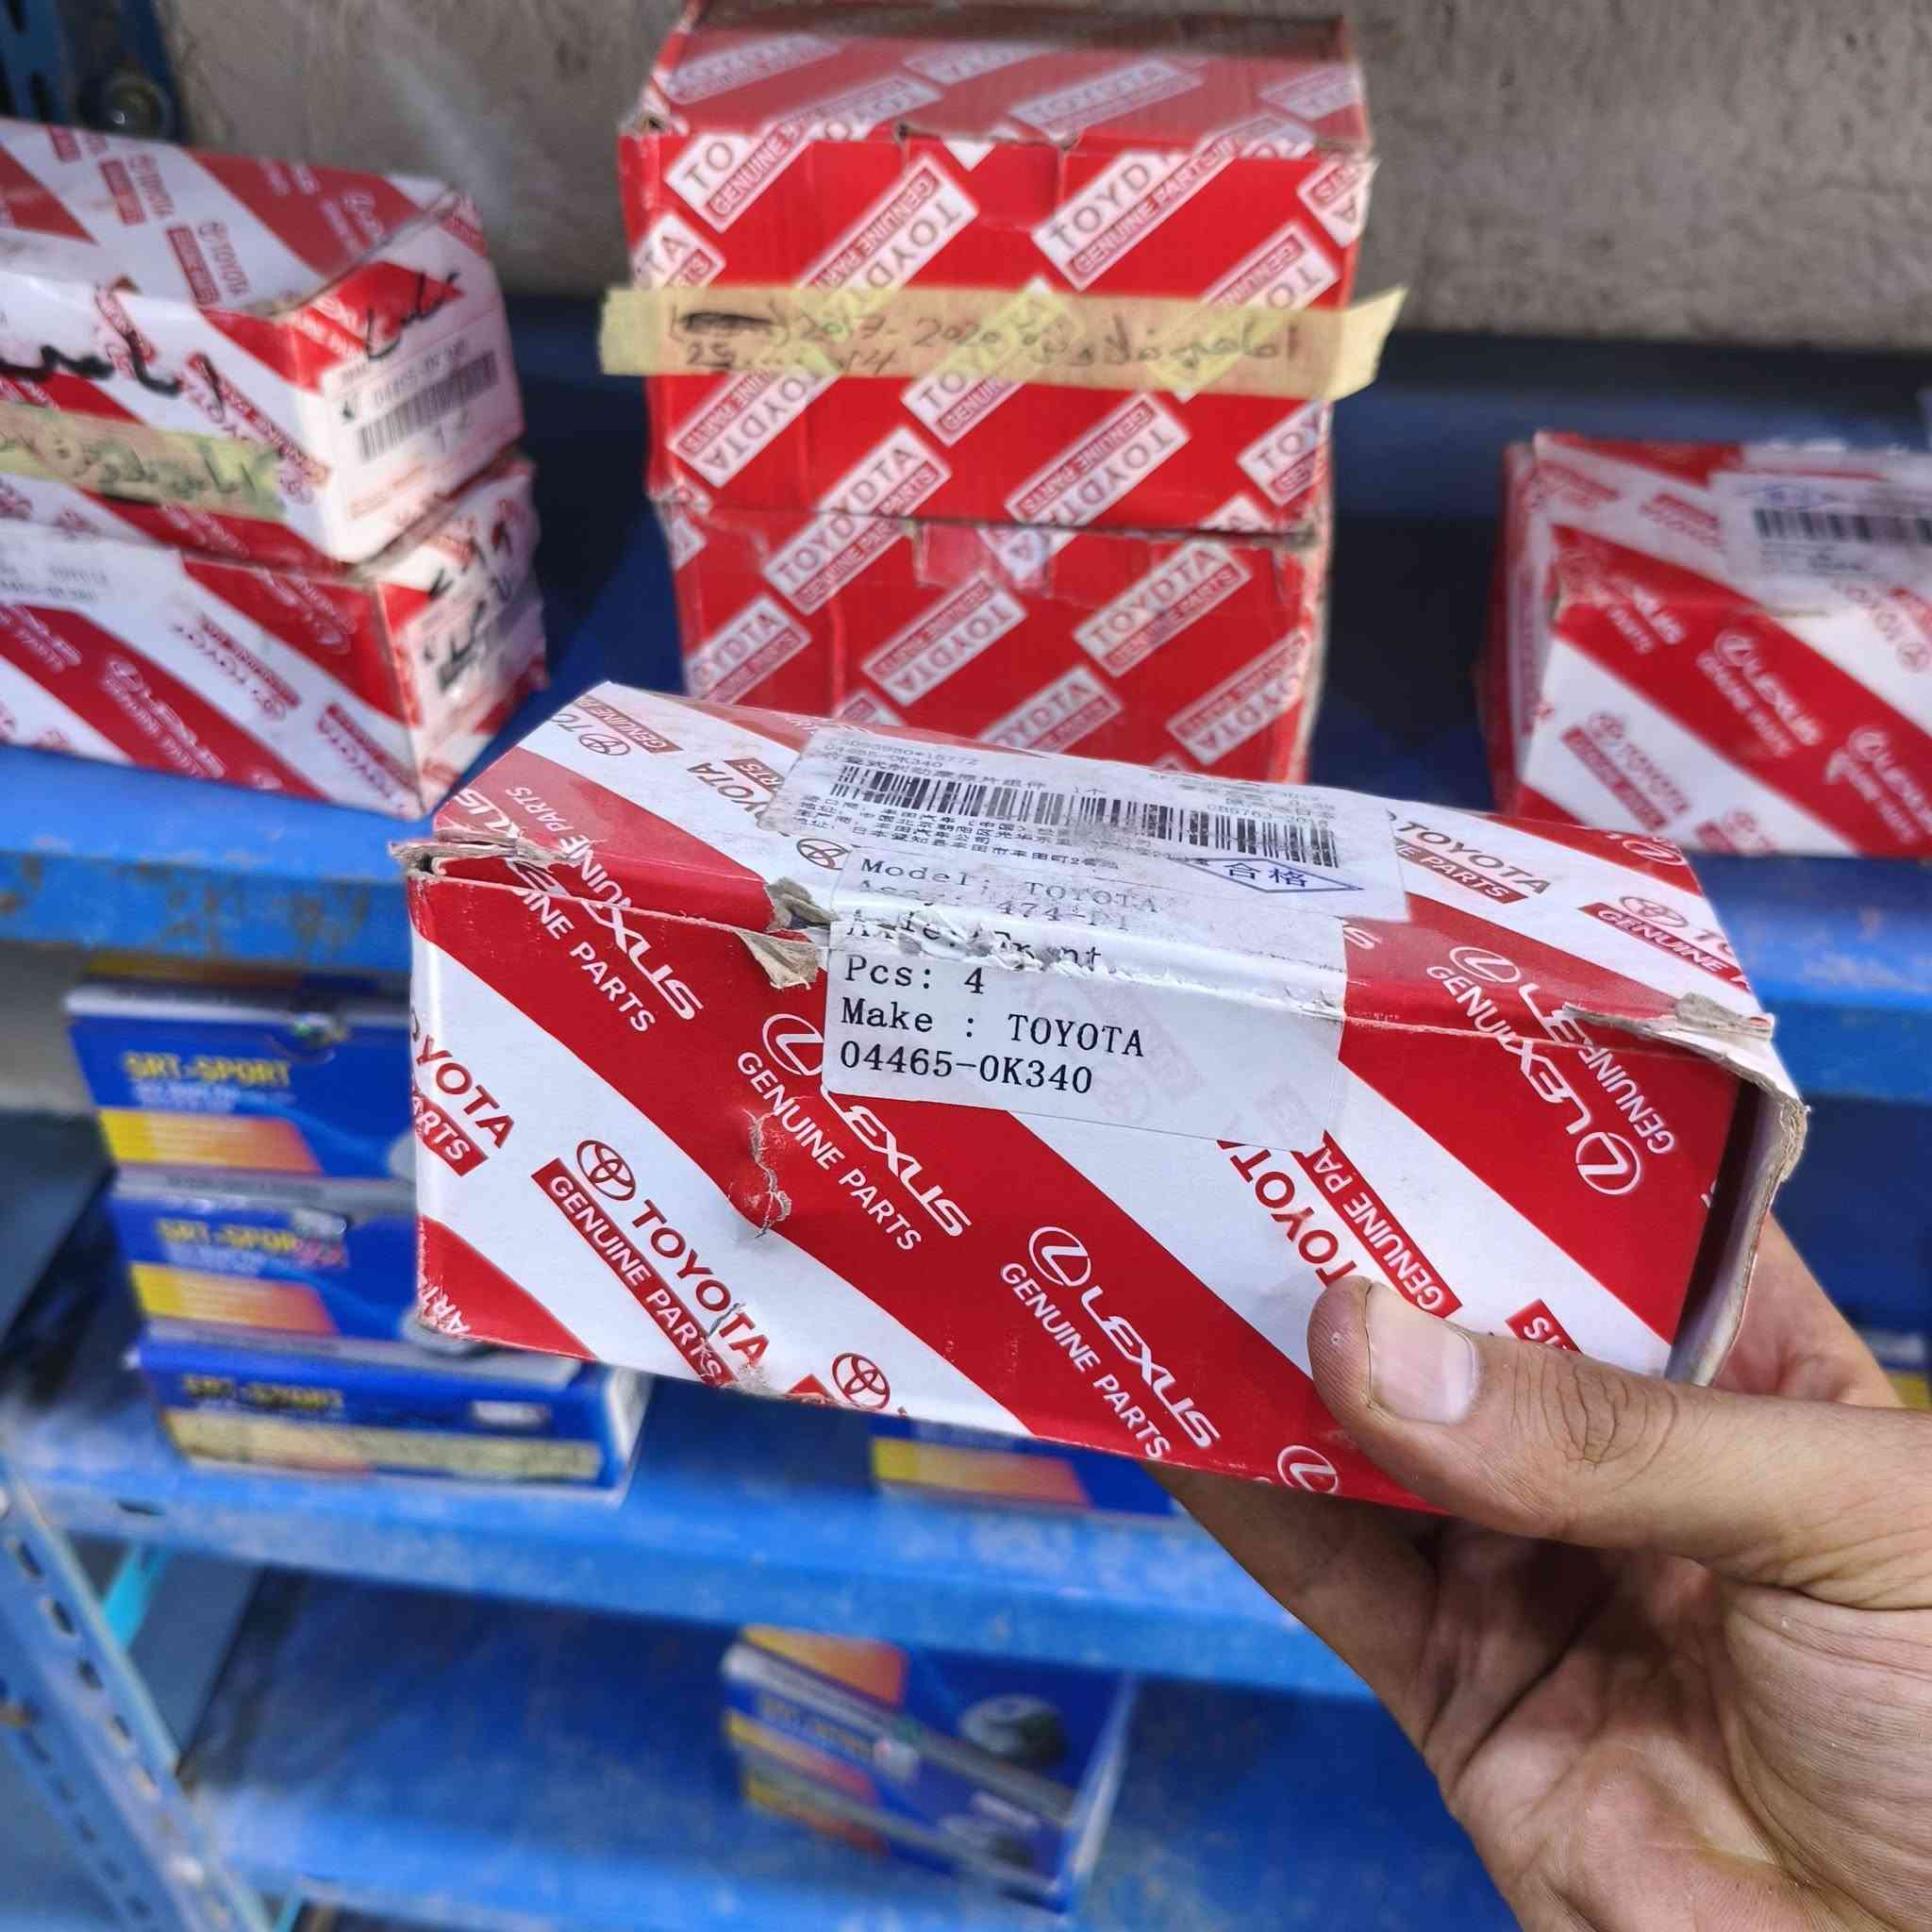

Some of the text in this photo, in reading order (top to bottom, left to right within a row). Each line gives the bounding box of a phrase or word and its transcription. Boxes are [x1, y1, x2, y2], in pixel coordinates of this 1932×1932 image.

[506, 787, 574, 832] PARTS
[1397, 821, 1551, 894] TOYOTA
[1223, 862, 1307, 888] 合格
[1421, 857, 1508, 896] PARTS
[570, 941, 656, 1031] PARTS
[844, 954, 985, 993] Pcs: 4
[1598, 910, 1728, 972] GENUINE
[840, 1041, 1092, 1094] 04465-0K340
[841, 997, 933, 1034] Make
[1008, 1014, 1144, 1058] TOYOTA
[416, 1034, 514, 1149] YOTA
[737, 1052, 922, 1251] GENUINE PARTS
[820, 1085, 973, 1237] LEXUS
[1217, 1141, 1357, 1288] TOYOT
[1343, 1192, 1444, 1310] GENUINE
[550, 1175, 722, 1375] GENUINE PARTS
[632, 1199, 770, 1368] TOYOTA
[1001, 1263, 1171, 1460] GENUINE PARTS
[1081, 1286, 1221, 1448] LEXUS
